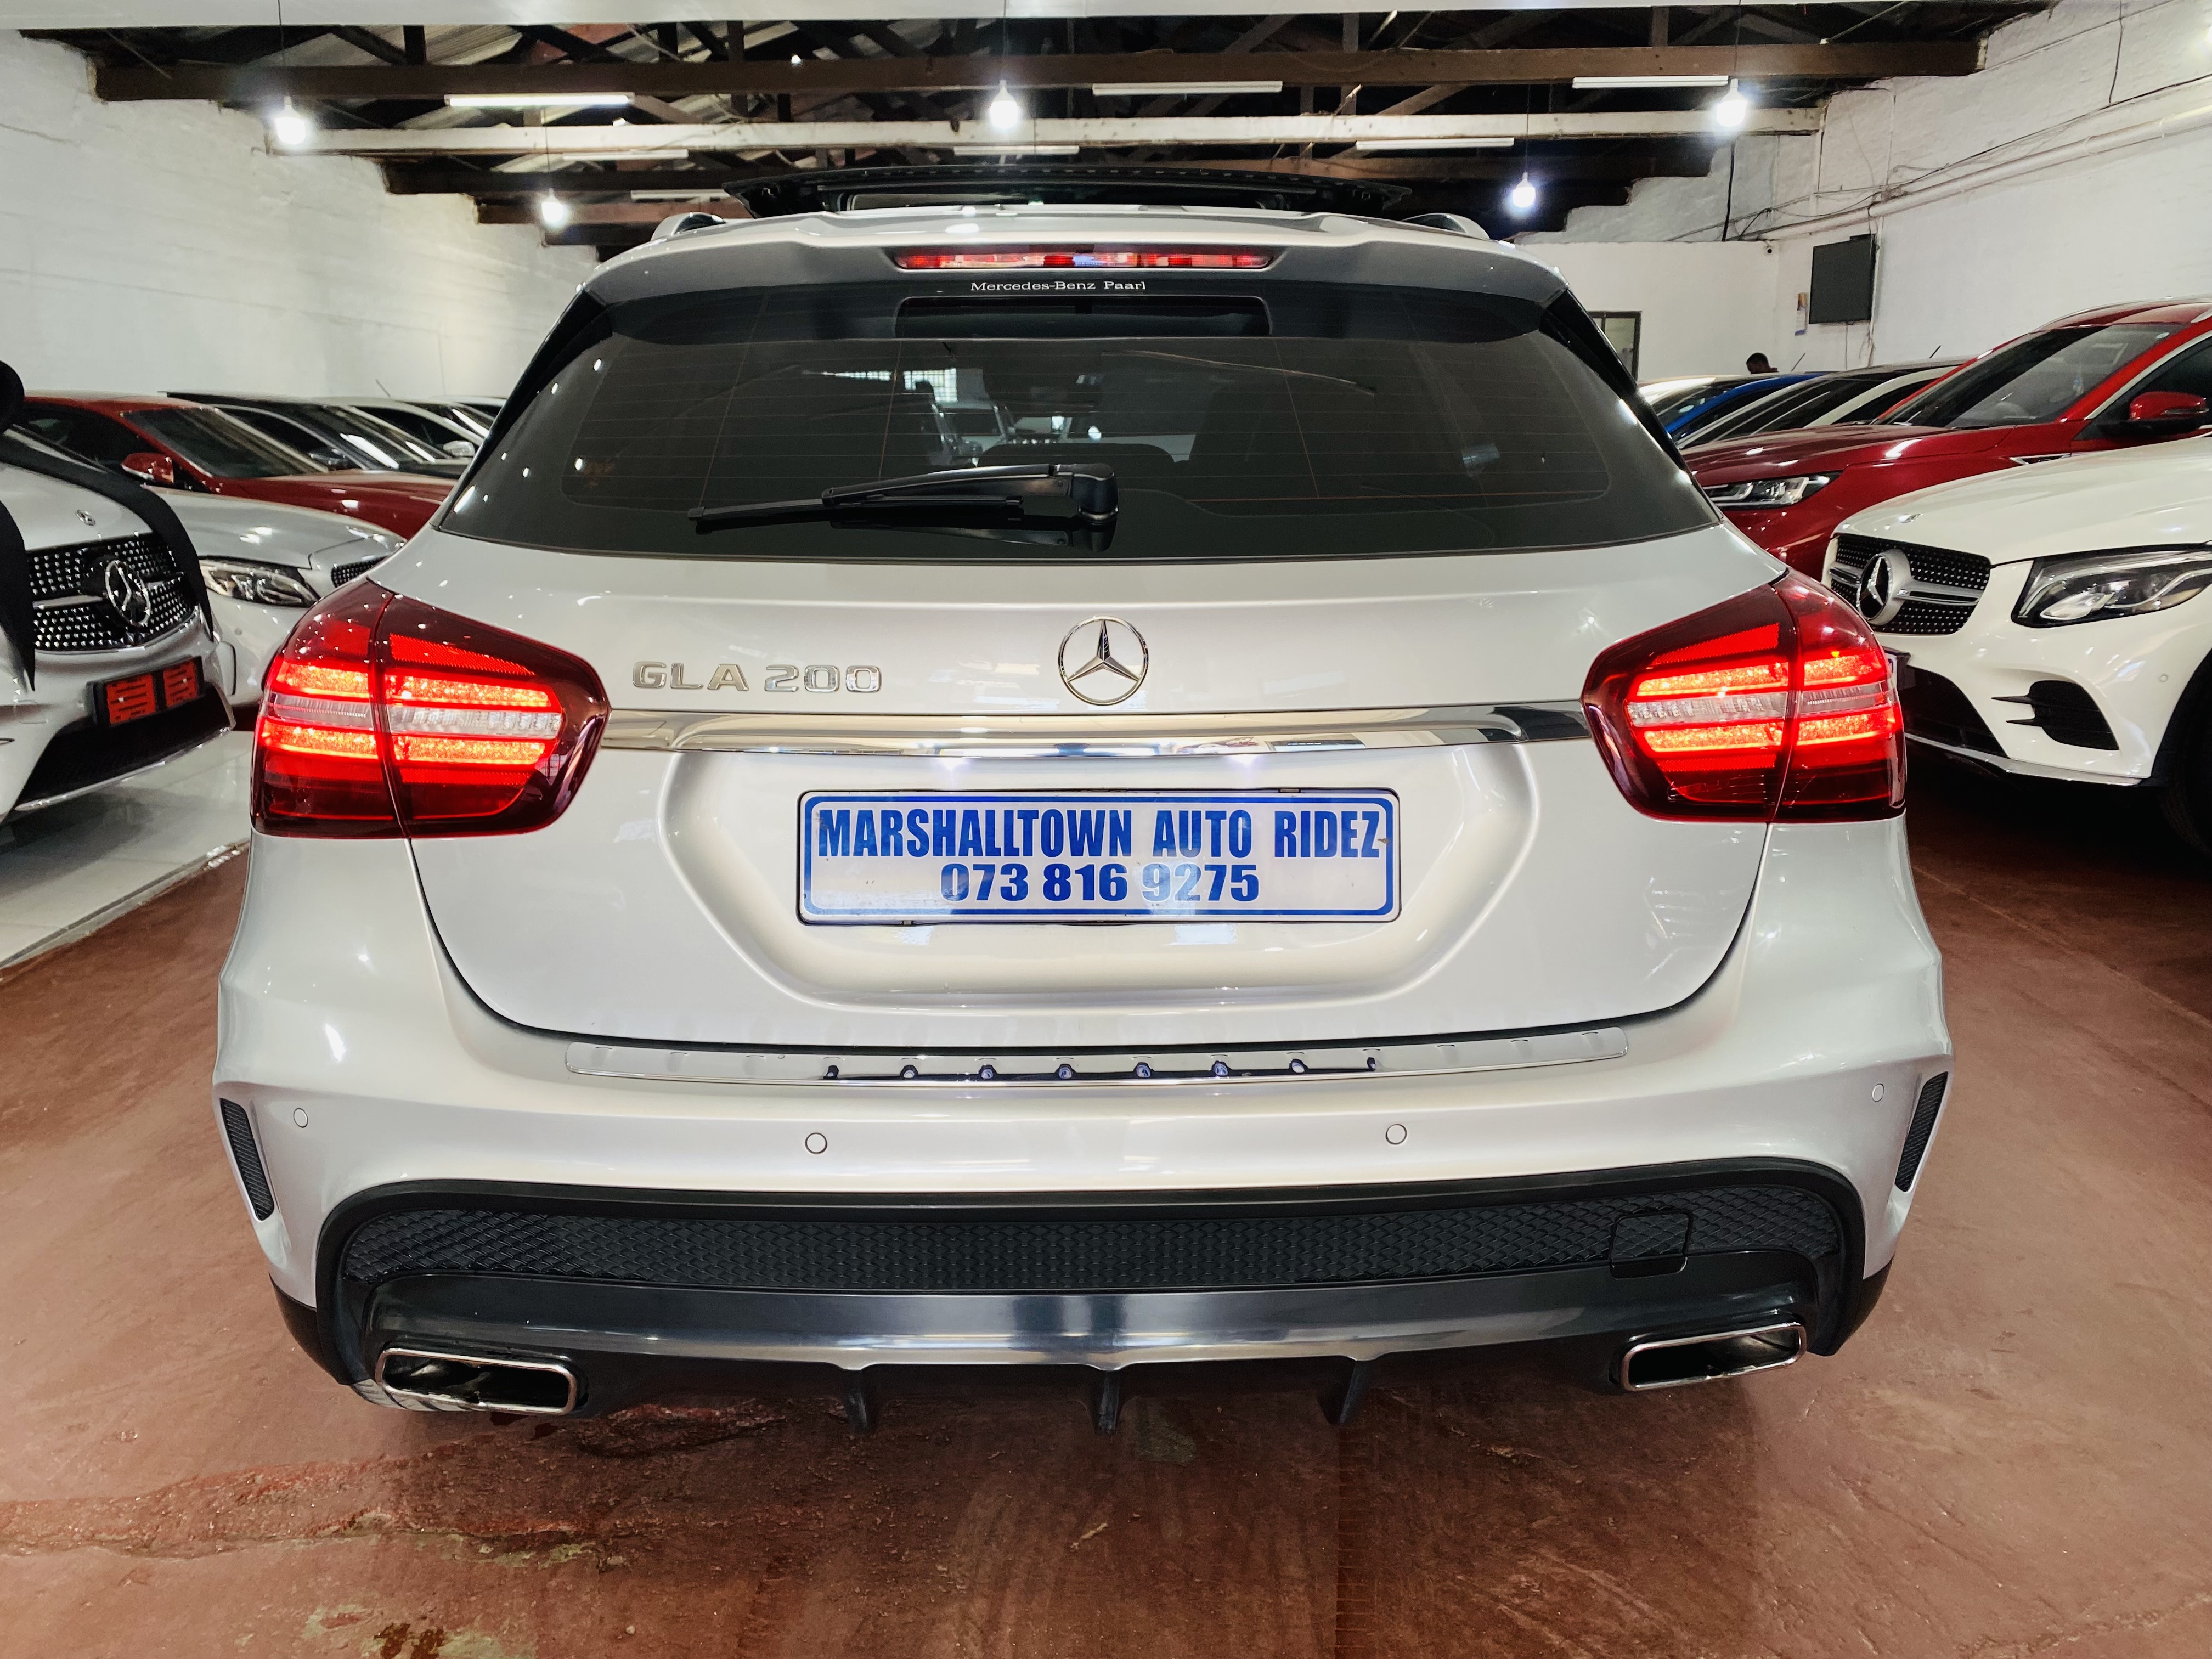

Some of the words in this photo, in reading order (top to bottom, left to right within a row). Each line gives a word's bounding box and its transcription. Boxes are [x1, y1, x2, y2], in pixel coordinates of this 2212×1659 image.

[970, 281, 1096, 291] Mercedes-Benz
[1103, 281, 1146, 291] Paarl
[633, 661, 749, 691] GLA
[764, 664, 882, 693] 200
[818, 809, 1131, 857] MARSHALLTOWN
[1153, 809, 1251, 857] AUTO
[1274, 809, 1380, 857] RIDEZ
[941, 863, 1028, 901] 073
[1042, 863, 1127, 901] 816
[1142, 863, 1259, 901] 9275
